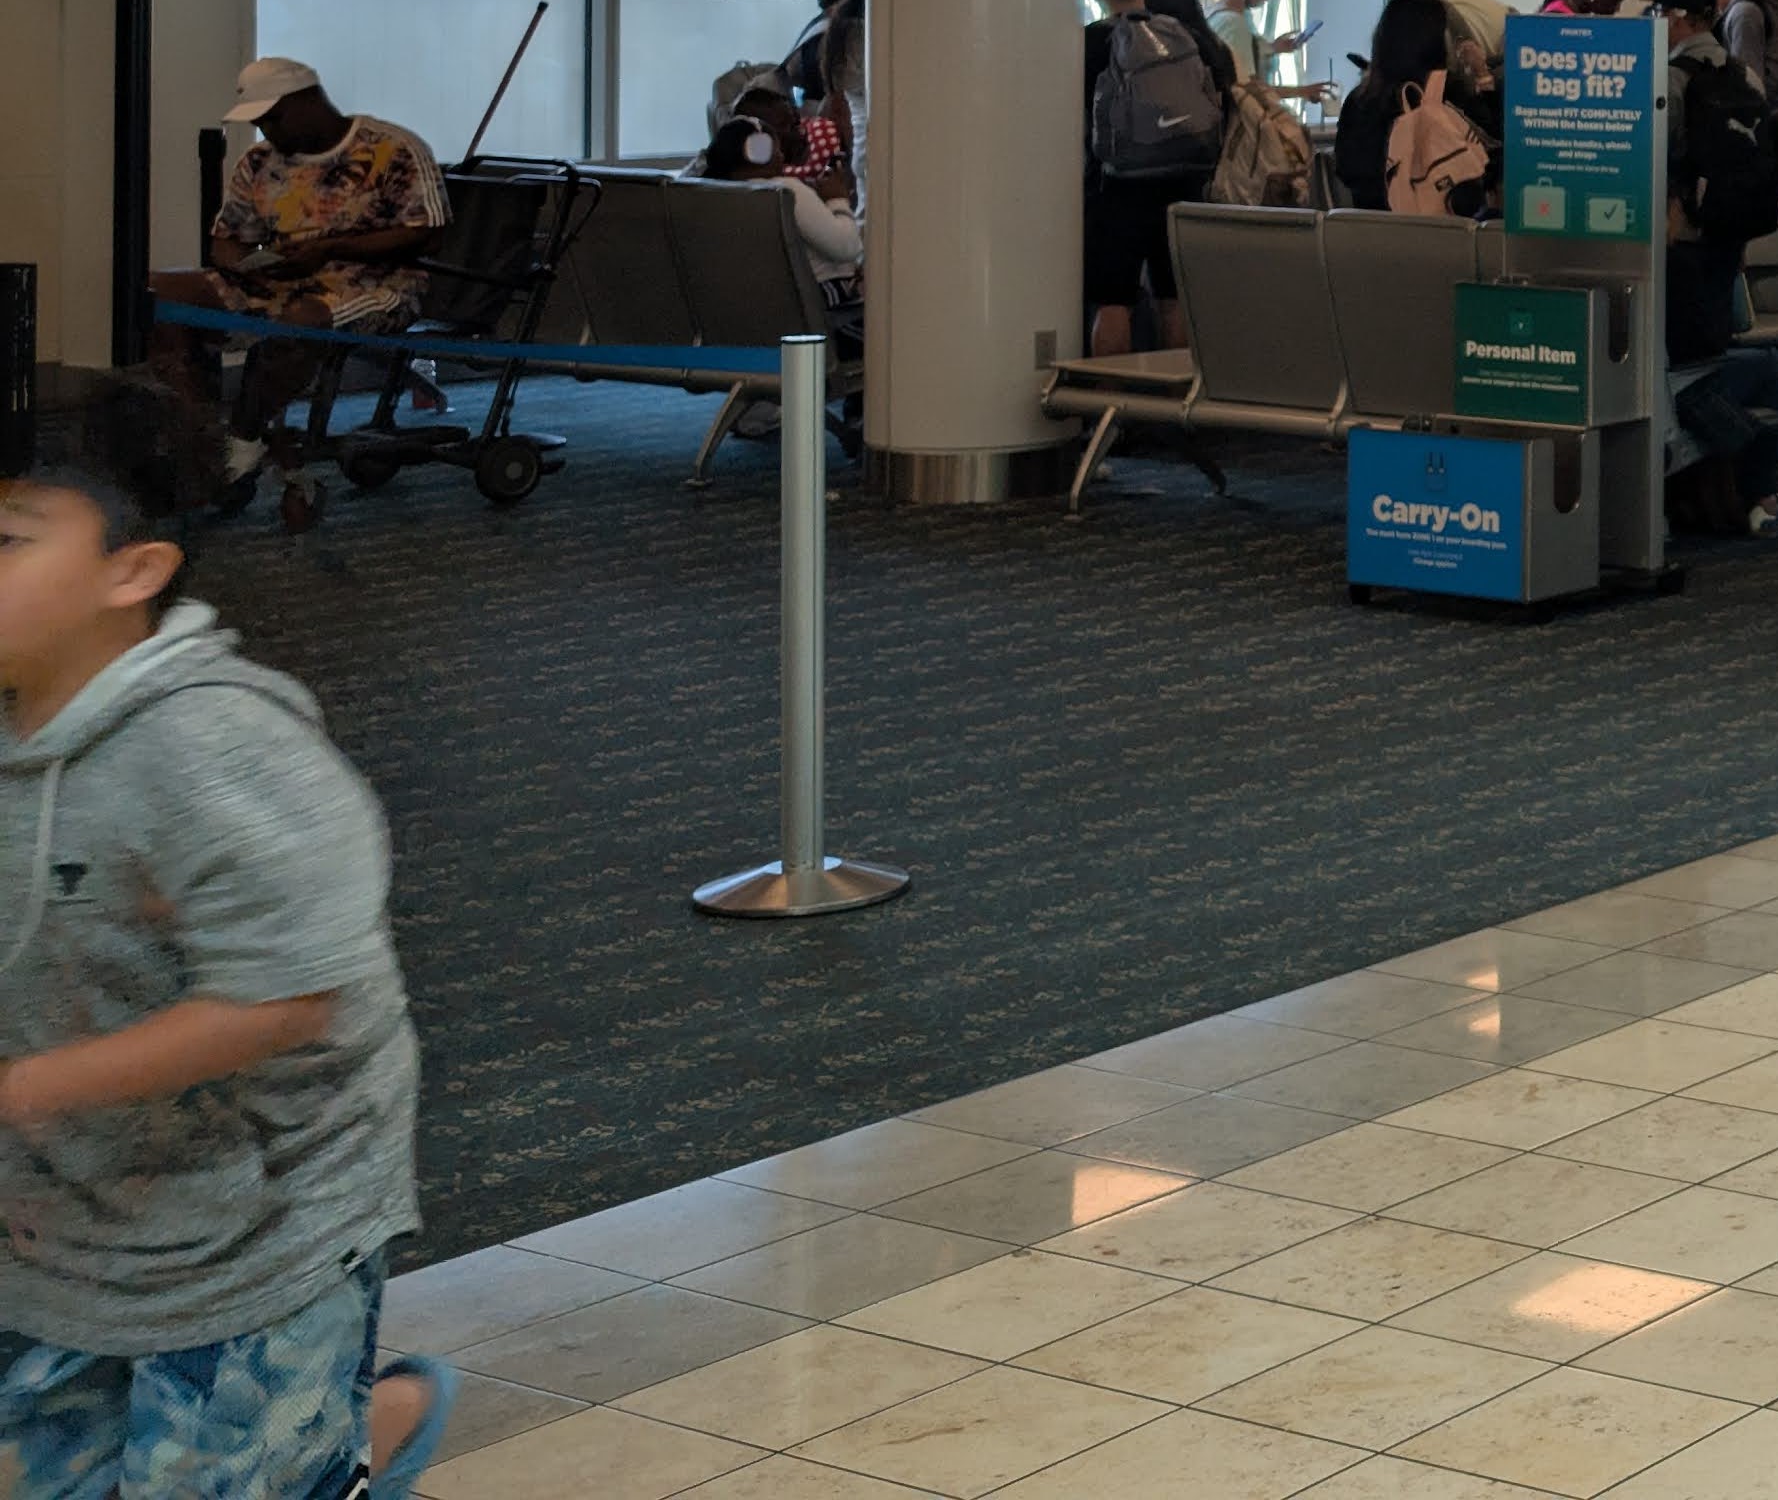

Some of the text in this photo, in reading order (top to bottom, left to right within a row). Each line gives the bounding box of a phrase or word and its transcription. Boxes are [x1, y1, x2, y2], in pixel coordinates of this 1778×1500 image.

[1520, 46, 1637, 75] Does your
[1536, 73, 1626, 100] bag fit?
[1564, 108, 1579, 118] FIT
[1581, 108, 1641, 120] COMPLETELY
[1465, 340, 1576, 365] Personal Item
[1372, 494, 1500, 533] Carry-On
